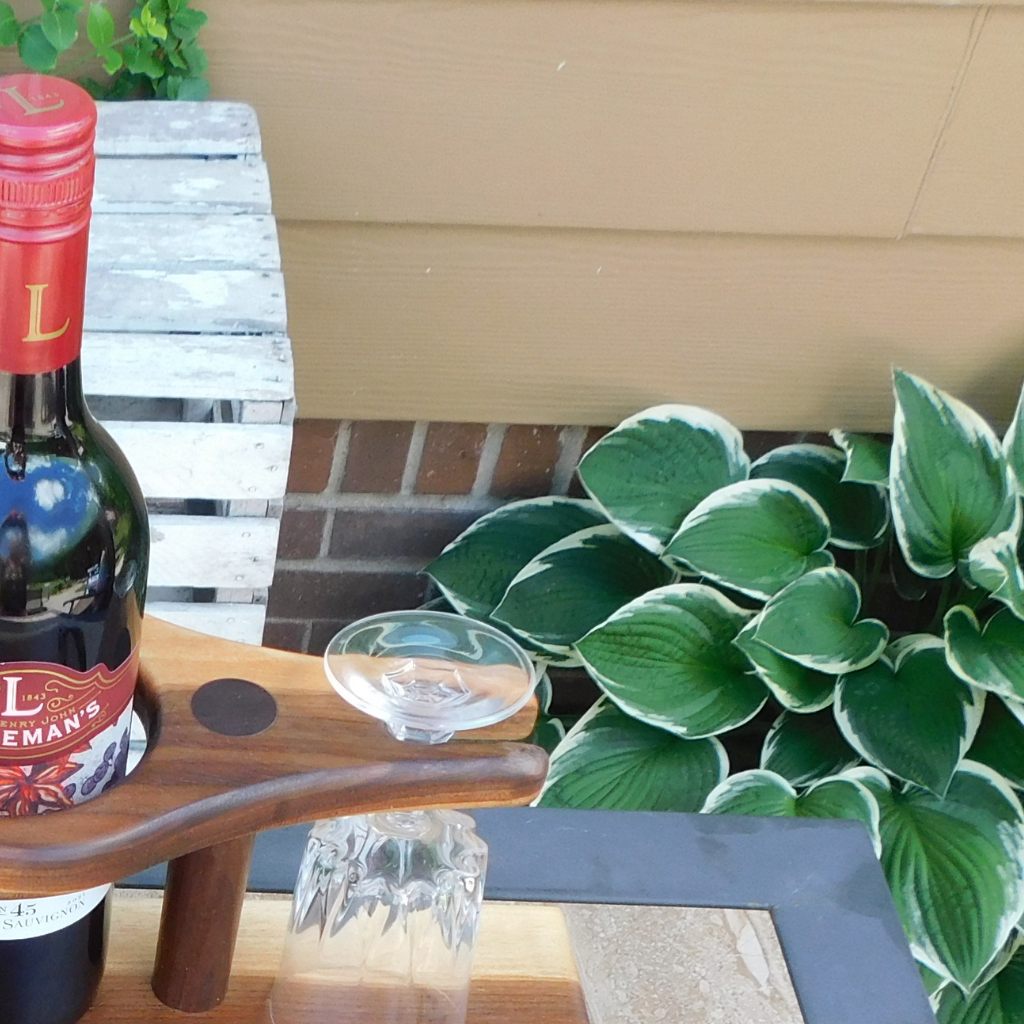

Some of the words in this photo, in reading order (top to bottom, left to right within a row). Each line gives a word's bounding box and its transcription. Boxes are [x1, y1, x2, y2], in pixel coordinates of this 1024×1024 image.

[1, 86, 65, 116] L
[21, 284, 71, 342] L
[0, 676, 44, 717] L
[21, 692, 47, 702] 1843
[41, 706, 76, 725] JOHN
[2, 897, 86, 930] SAUVIGNON
[10, 902, 38, 918] 45
